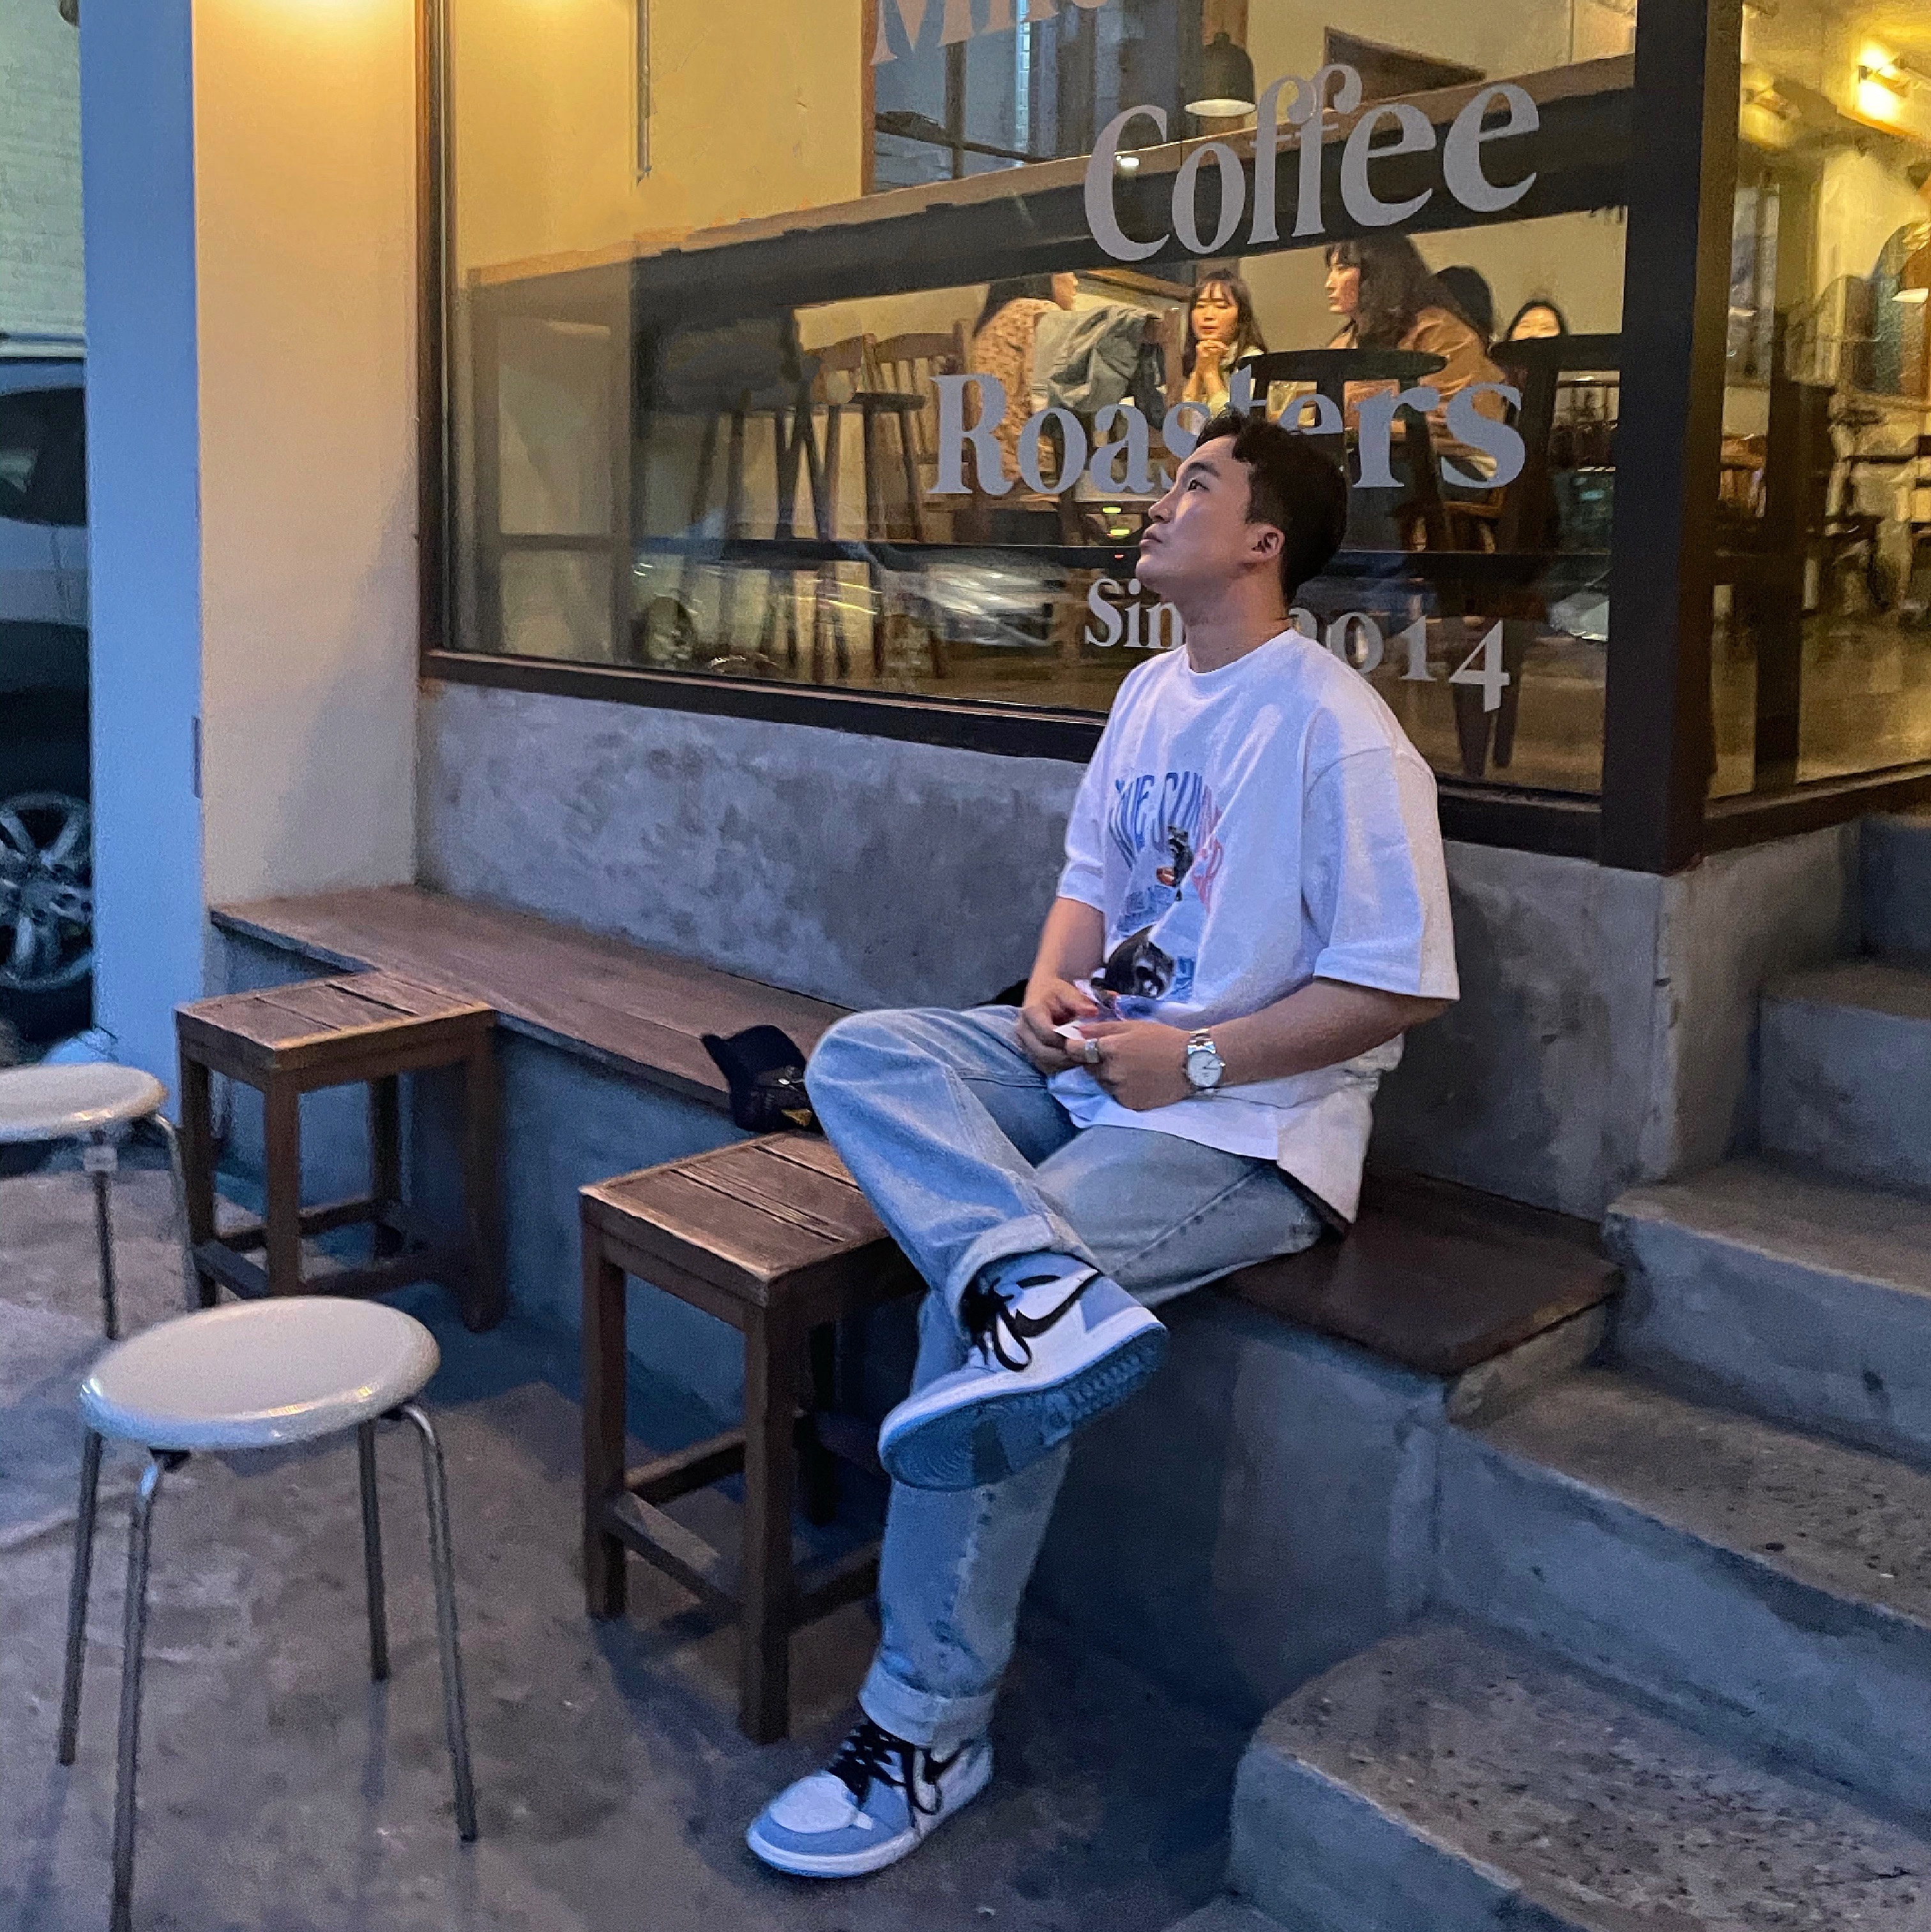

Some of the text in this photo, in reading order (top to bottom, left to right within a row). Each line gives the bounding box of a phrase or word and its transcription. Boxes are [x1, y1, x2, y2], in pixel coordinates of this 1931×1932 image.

[1085, 64, 1540, 261] Coffee
[1084, 578, 1510, 712] Sin 014
